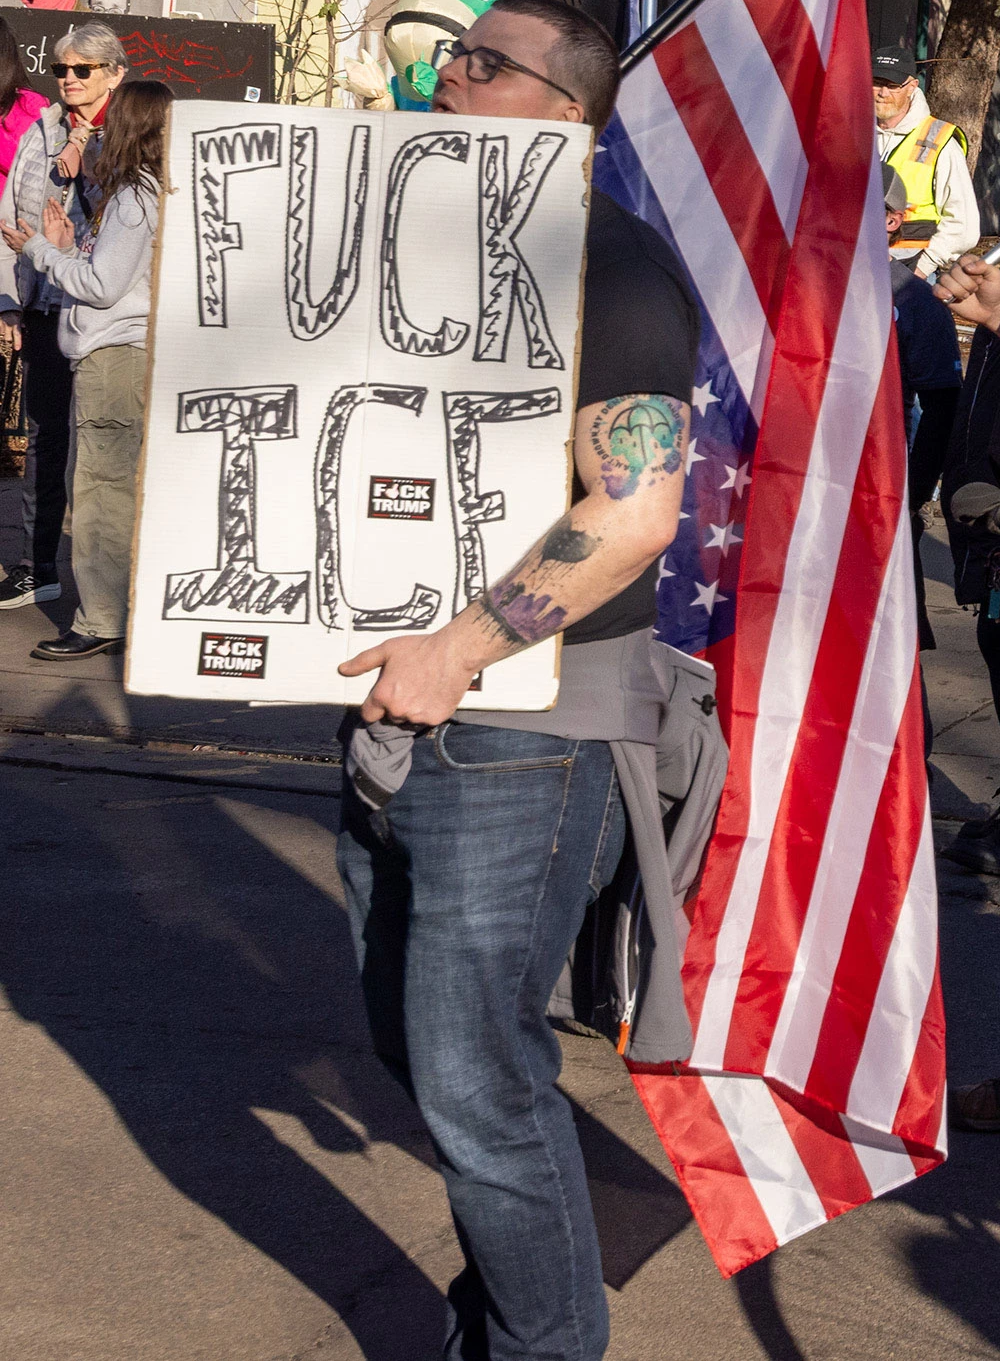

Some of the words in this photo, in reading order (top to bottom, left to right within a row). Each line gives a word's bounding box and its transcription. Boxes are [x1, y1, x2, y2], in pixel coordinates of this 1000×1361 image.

[191, 123, 570, 371] FUCK
[161, 382, 563, 634] ICE
[371, 498, 432, 515] TRUMP
[202, 655, 263, 672] TRUMP
